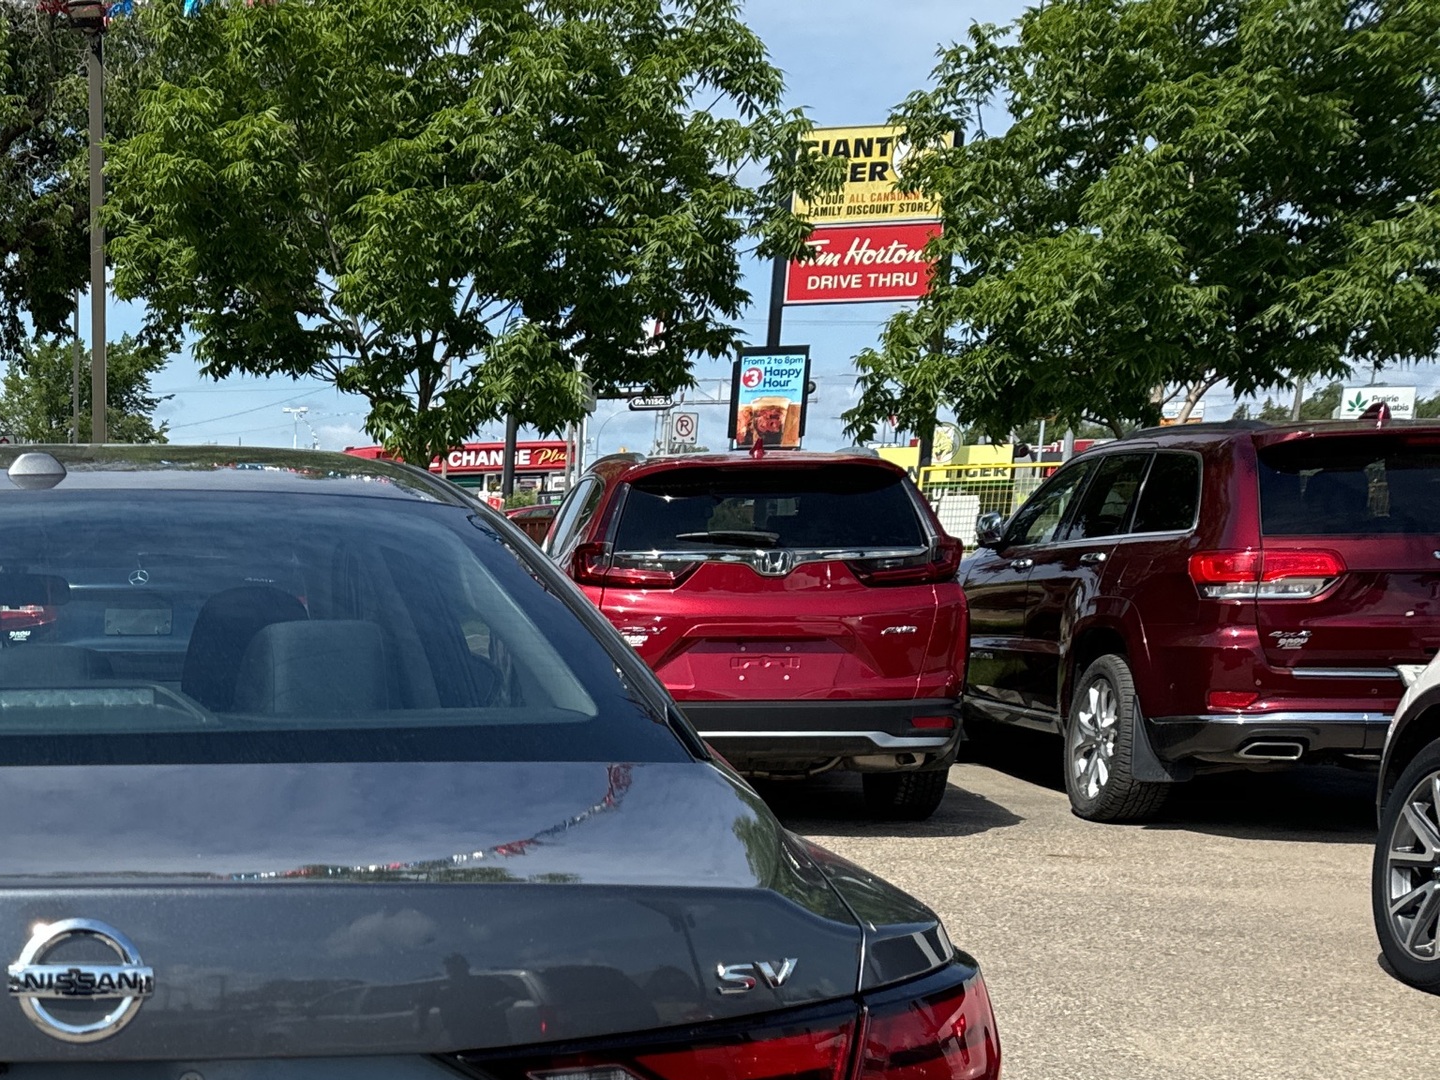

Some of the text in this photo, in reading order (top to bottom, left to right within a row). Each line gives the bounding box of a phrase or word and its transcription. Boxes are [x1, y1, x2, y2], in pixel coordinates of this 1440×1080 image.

[820, 194, 845, 205] YOUR
[849, 192, 866, 204] ALL
[808, 201, 930, 217] FAMILY DISCOUNT STORE
[843, 237, 931, 266] Horton
[806, 271, 918, 290] DRIVE THRU
[743, 357, 765, 365] From
[767, 356, 772, 365] 2
[784, 356, 803, 366] 8pm
[764, 366, 802, 378] Happy
[763, 377, 792, 388] Hour
[448, 449, 531, 467] CHANE
[533, 448, 568, 465] Plu
[24, 972, 138, 991] NISSAN
[717, 958, 798, 994] SV
